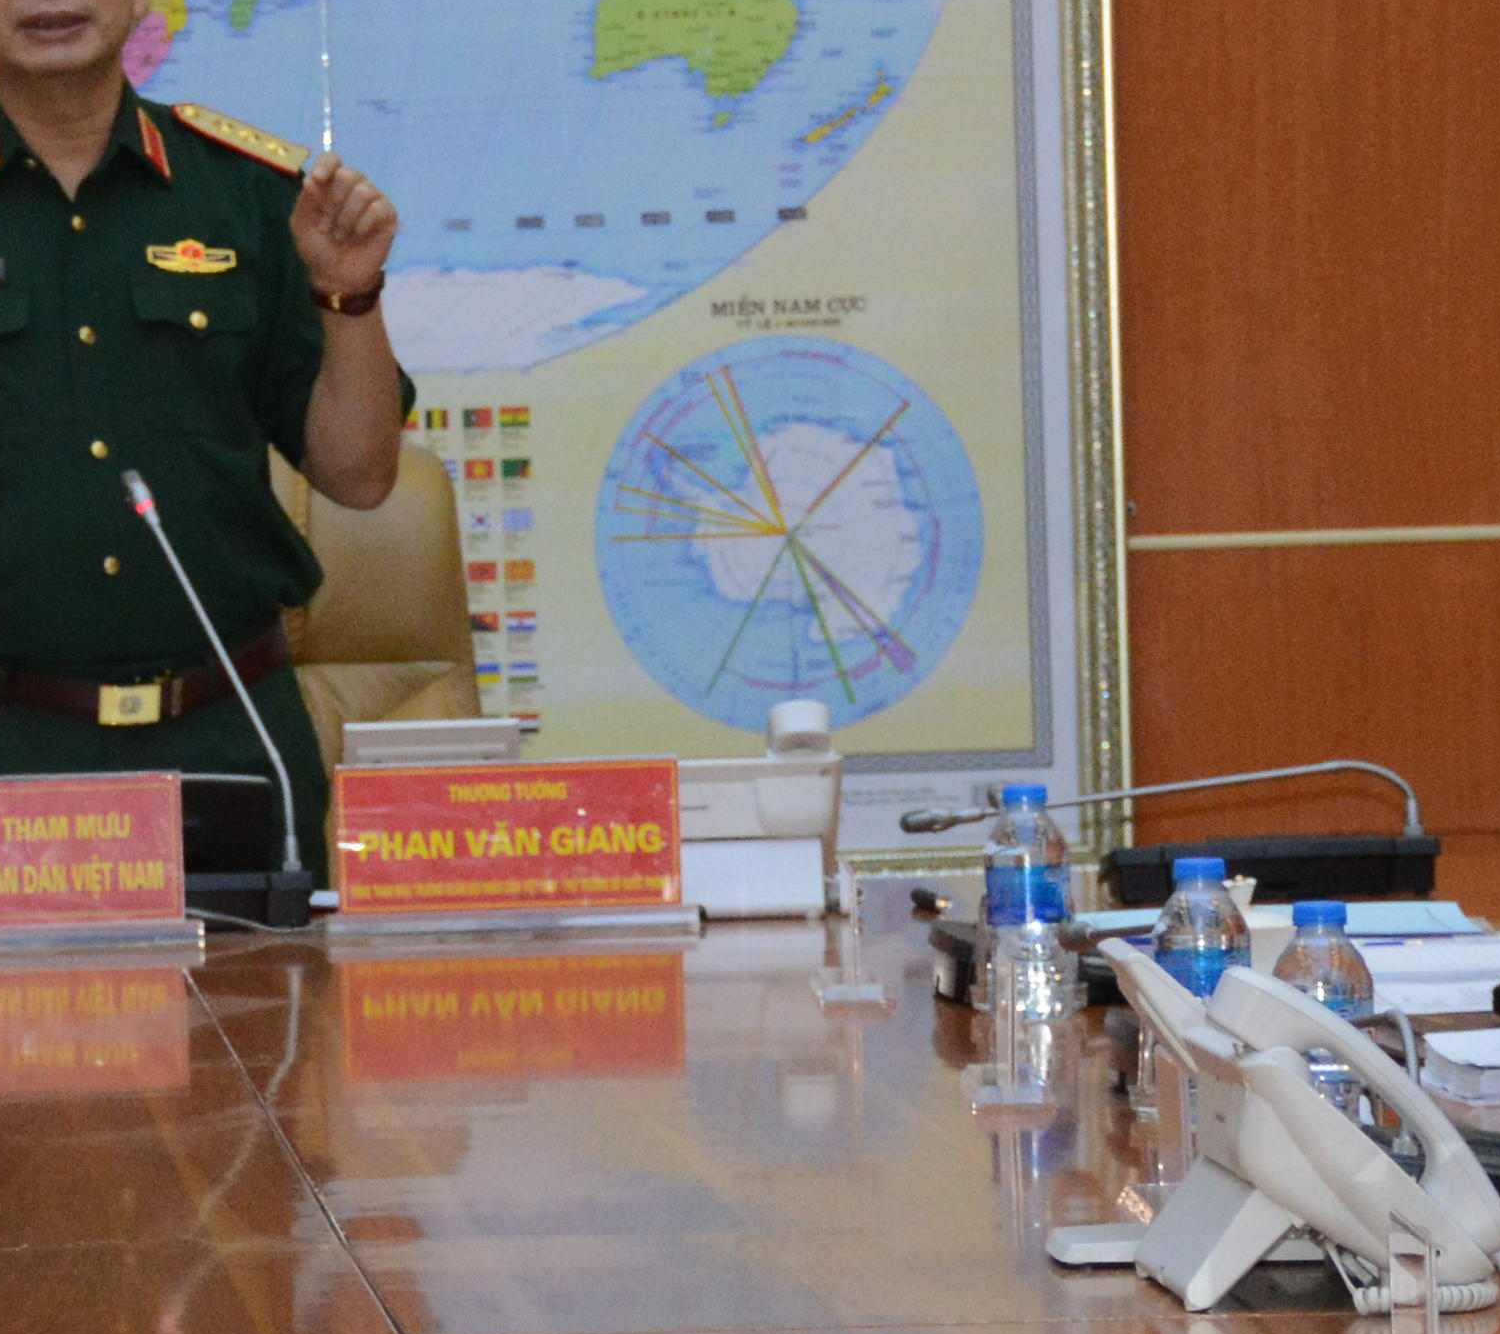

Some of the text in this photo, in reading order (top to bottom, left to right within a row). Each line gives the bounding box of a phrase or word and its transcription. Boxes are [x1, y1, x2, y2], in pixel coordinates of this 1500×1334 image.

[3, 815, 69, 842] THAM
[358, 821, 663, 860] PHAN VĂN GIANG
[23, 857, 68, 894] DÂN
[71, 854, 114, 900] VIỆT
[117, 860, 165, 891] NAM
